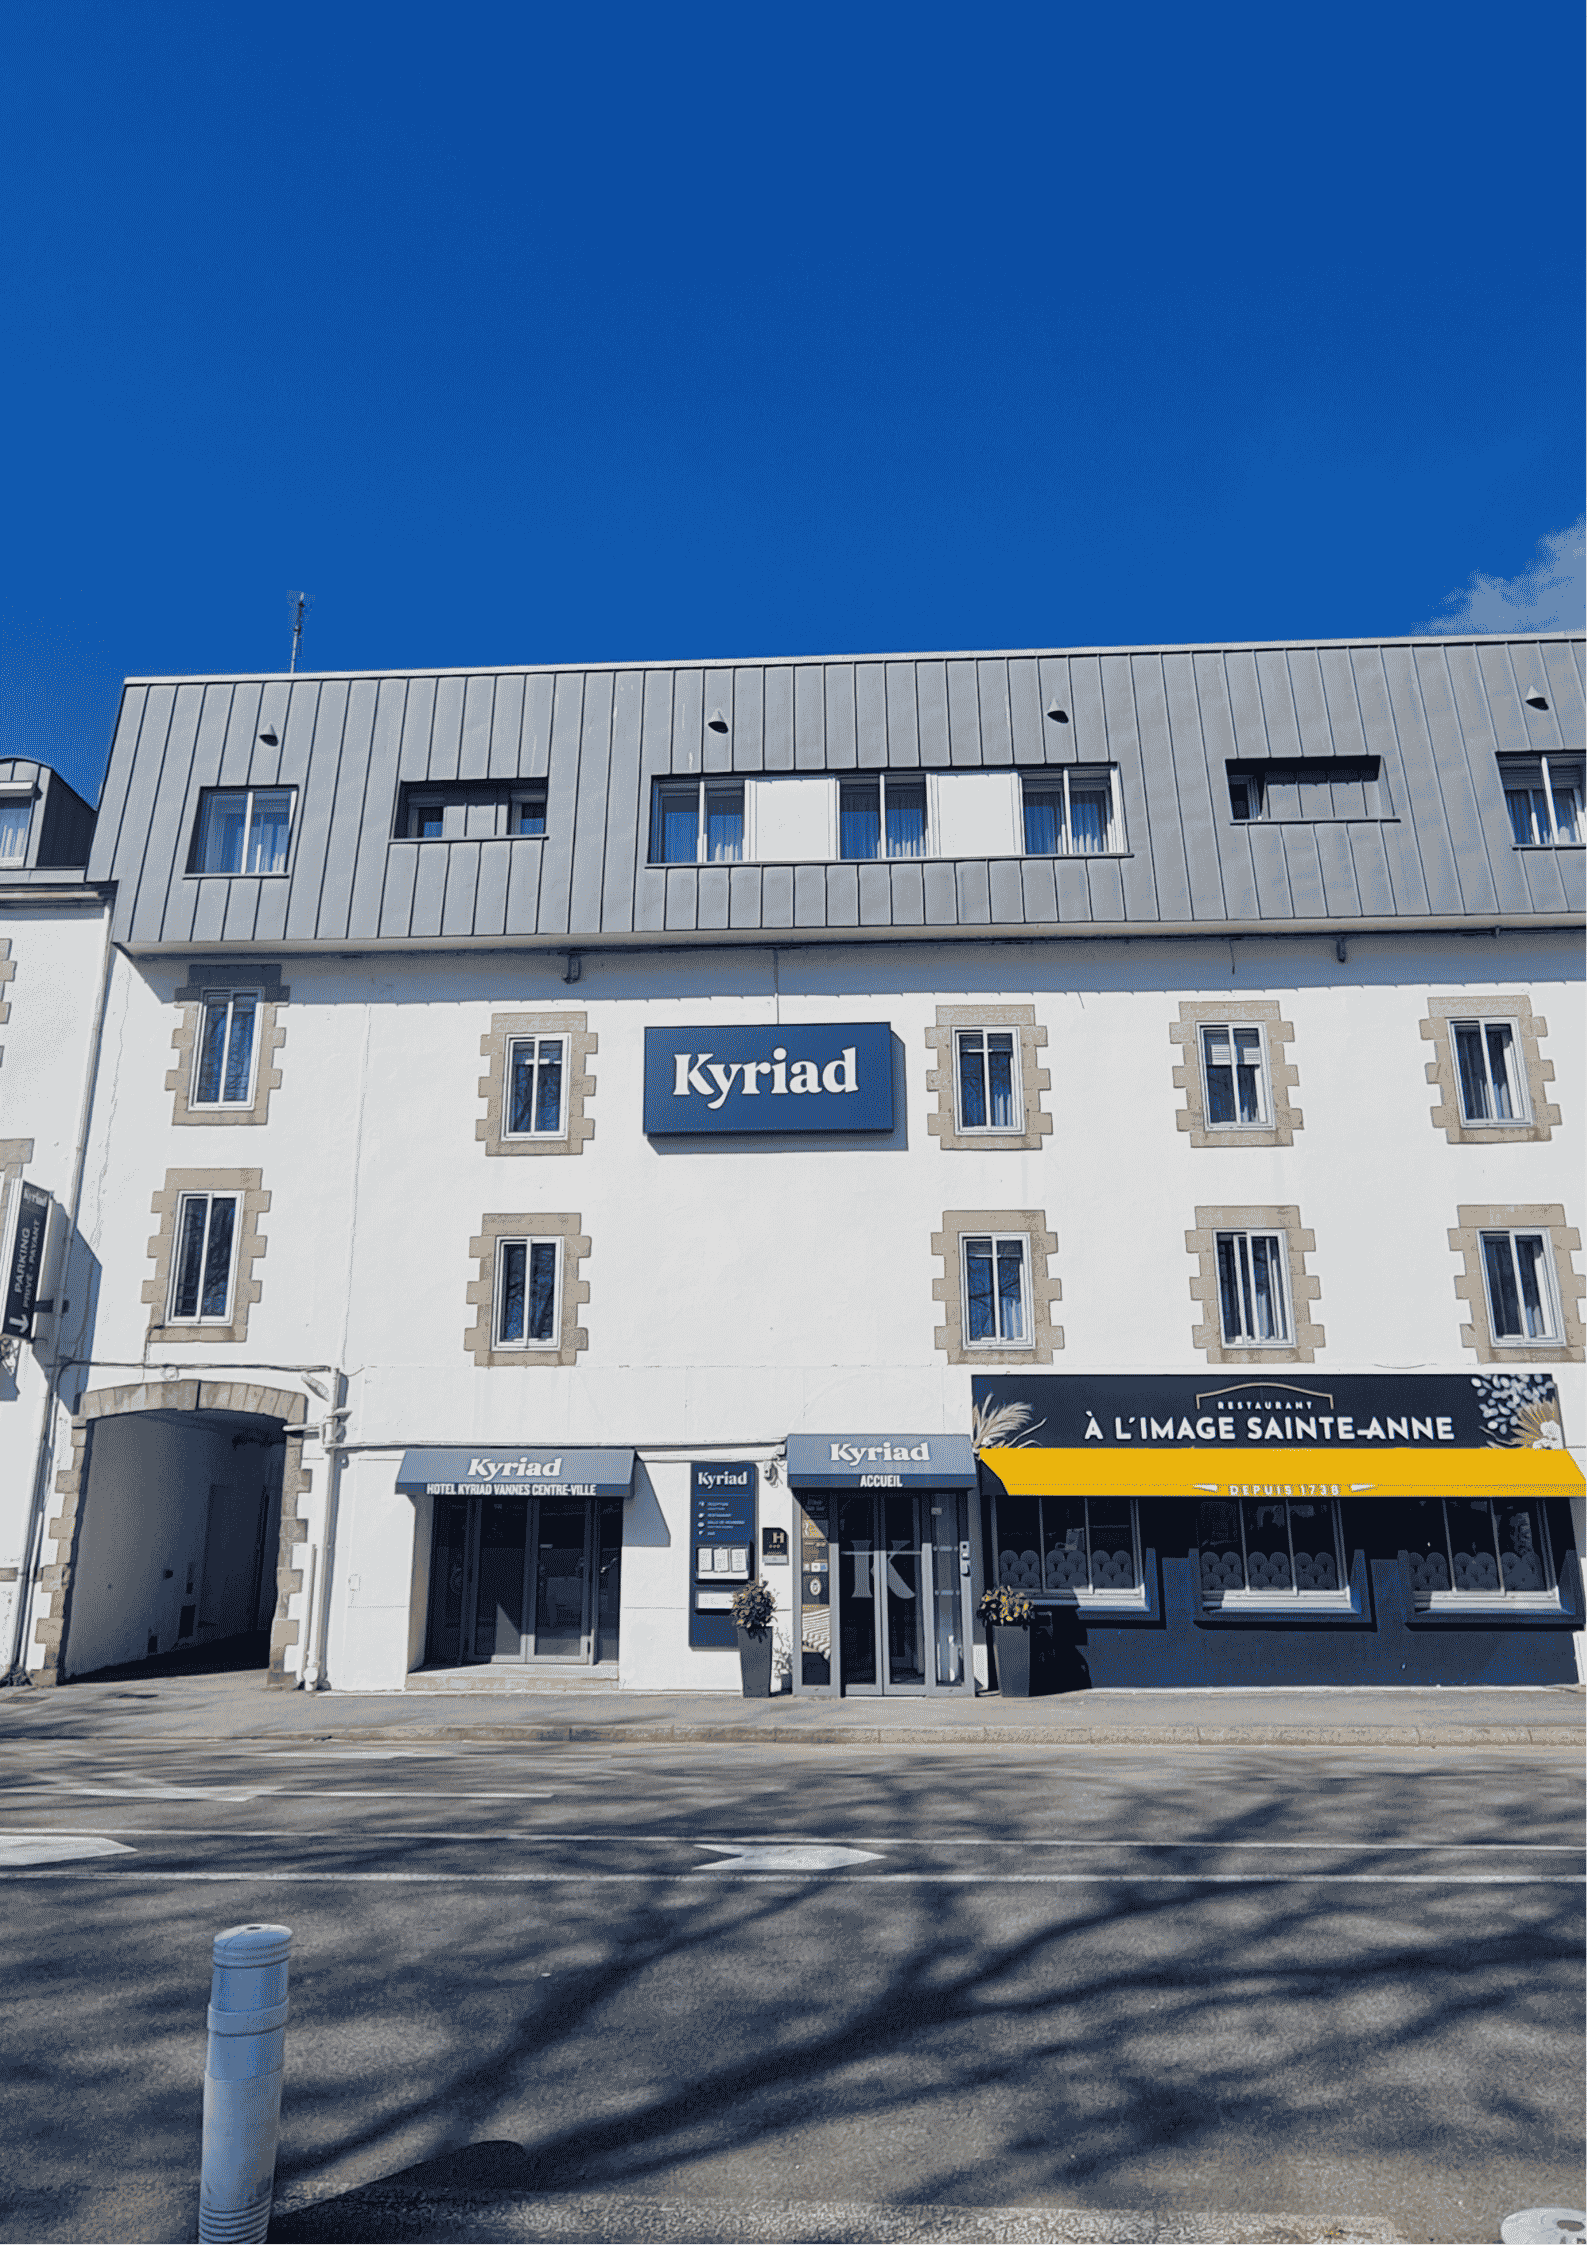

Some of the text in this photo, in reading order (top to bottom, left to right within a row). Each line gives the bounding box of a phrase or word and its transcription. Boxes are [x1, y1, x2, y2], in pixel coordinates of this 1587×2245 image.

[672, 1046, 860, 1110] Kyriad
[28, 1219, 40, 1264] PAYANT
[14, 1227, 31, 1293] PARKING
[1217, 1401, 1313, 1410] RESTAURANT
[1084, 1411, 1455, 1441] À L'IMAGE SAINTE-ANNE
[829, 1442, 931, 1467] Kyriad
[467, 1456, 563, 1482] Kyriad
[457, 1484, 492, 1496] KYRIAD
[493, 1484, 531, 1496] VANNES
[531, 1484, 597, 1496] CENTRE-VILLE
[698, 1471, 748, 1489] Kyriad
[860, 1475, 903, 1488] ACCUEIL
[1229, 1484, 1340, 1496] DEPUIS 1738
[773, 1532, 784, 1543] H
